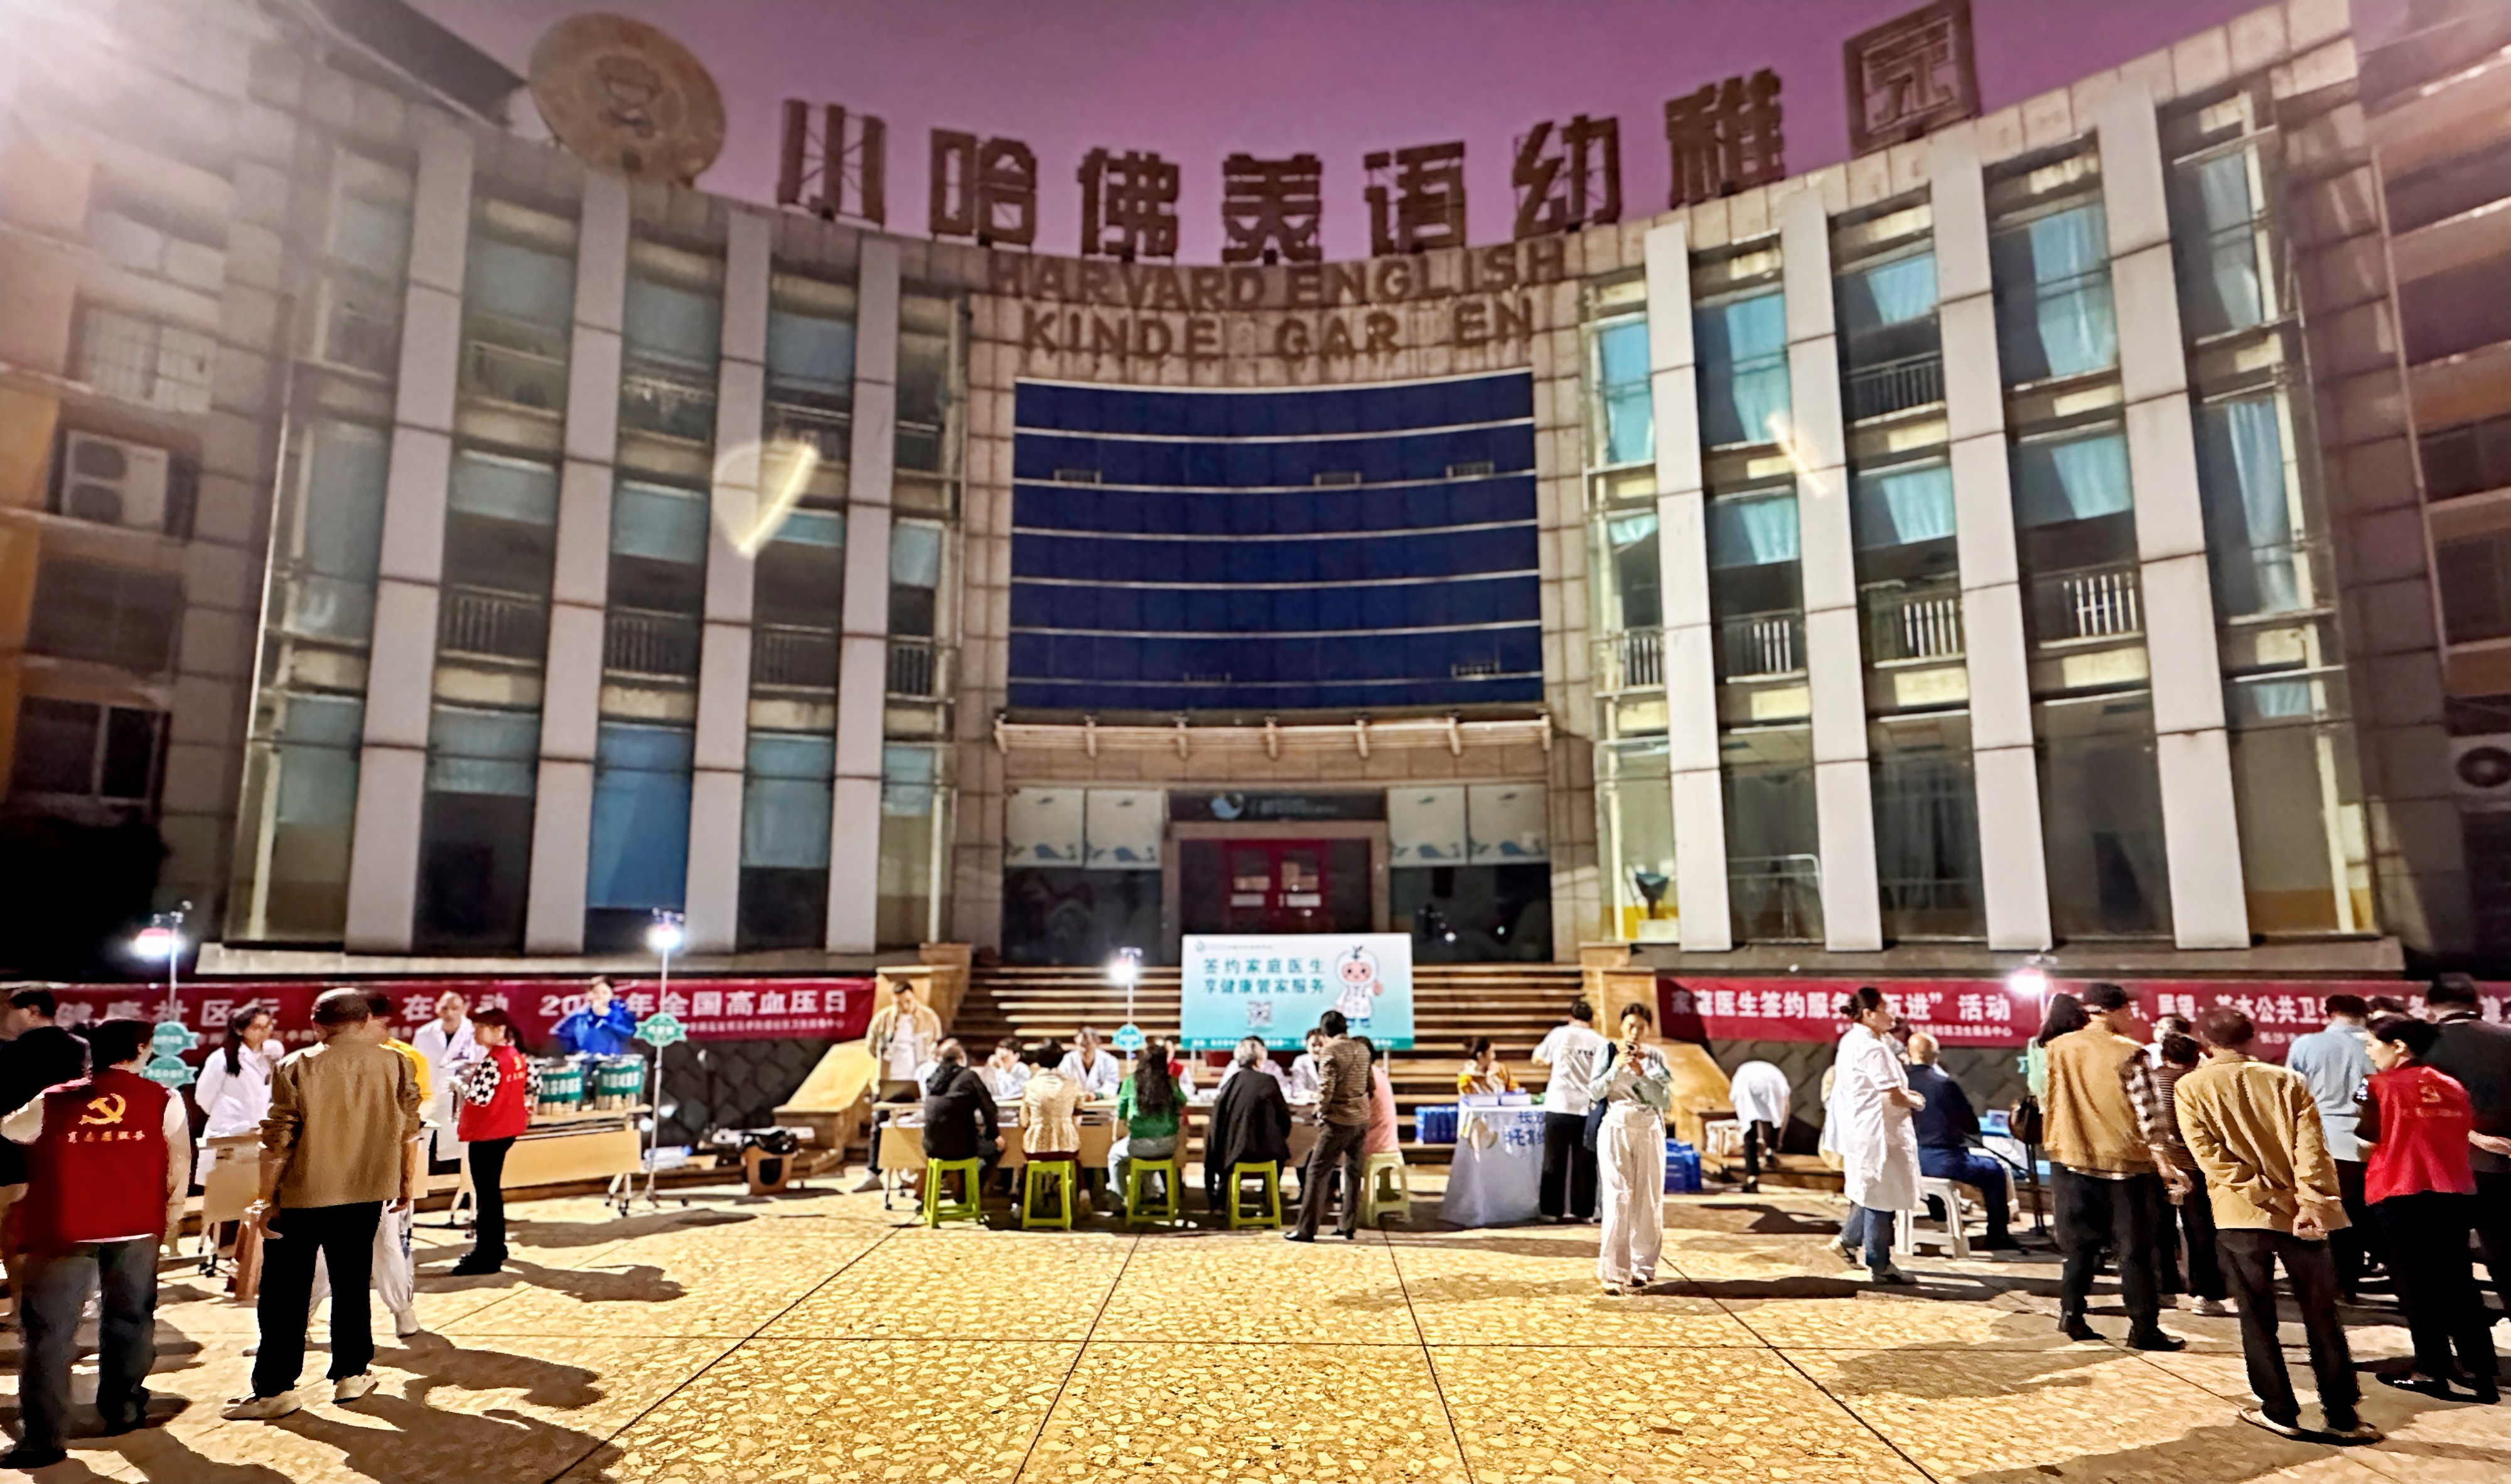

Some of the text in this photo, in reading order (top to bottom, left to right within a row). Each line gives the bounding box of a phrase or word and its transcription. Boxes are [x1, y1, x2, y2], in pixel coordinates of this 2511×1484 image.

[990, 239, 1565, 308] HARVARD ENGLISH
[1203, 958, 1325, 974] 签约家庭医生
[1203, 979, 1325, 994] 享健康管家服务
[1957, 993, 2011, 1021] 活动
